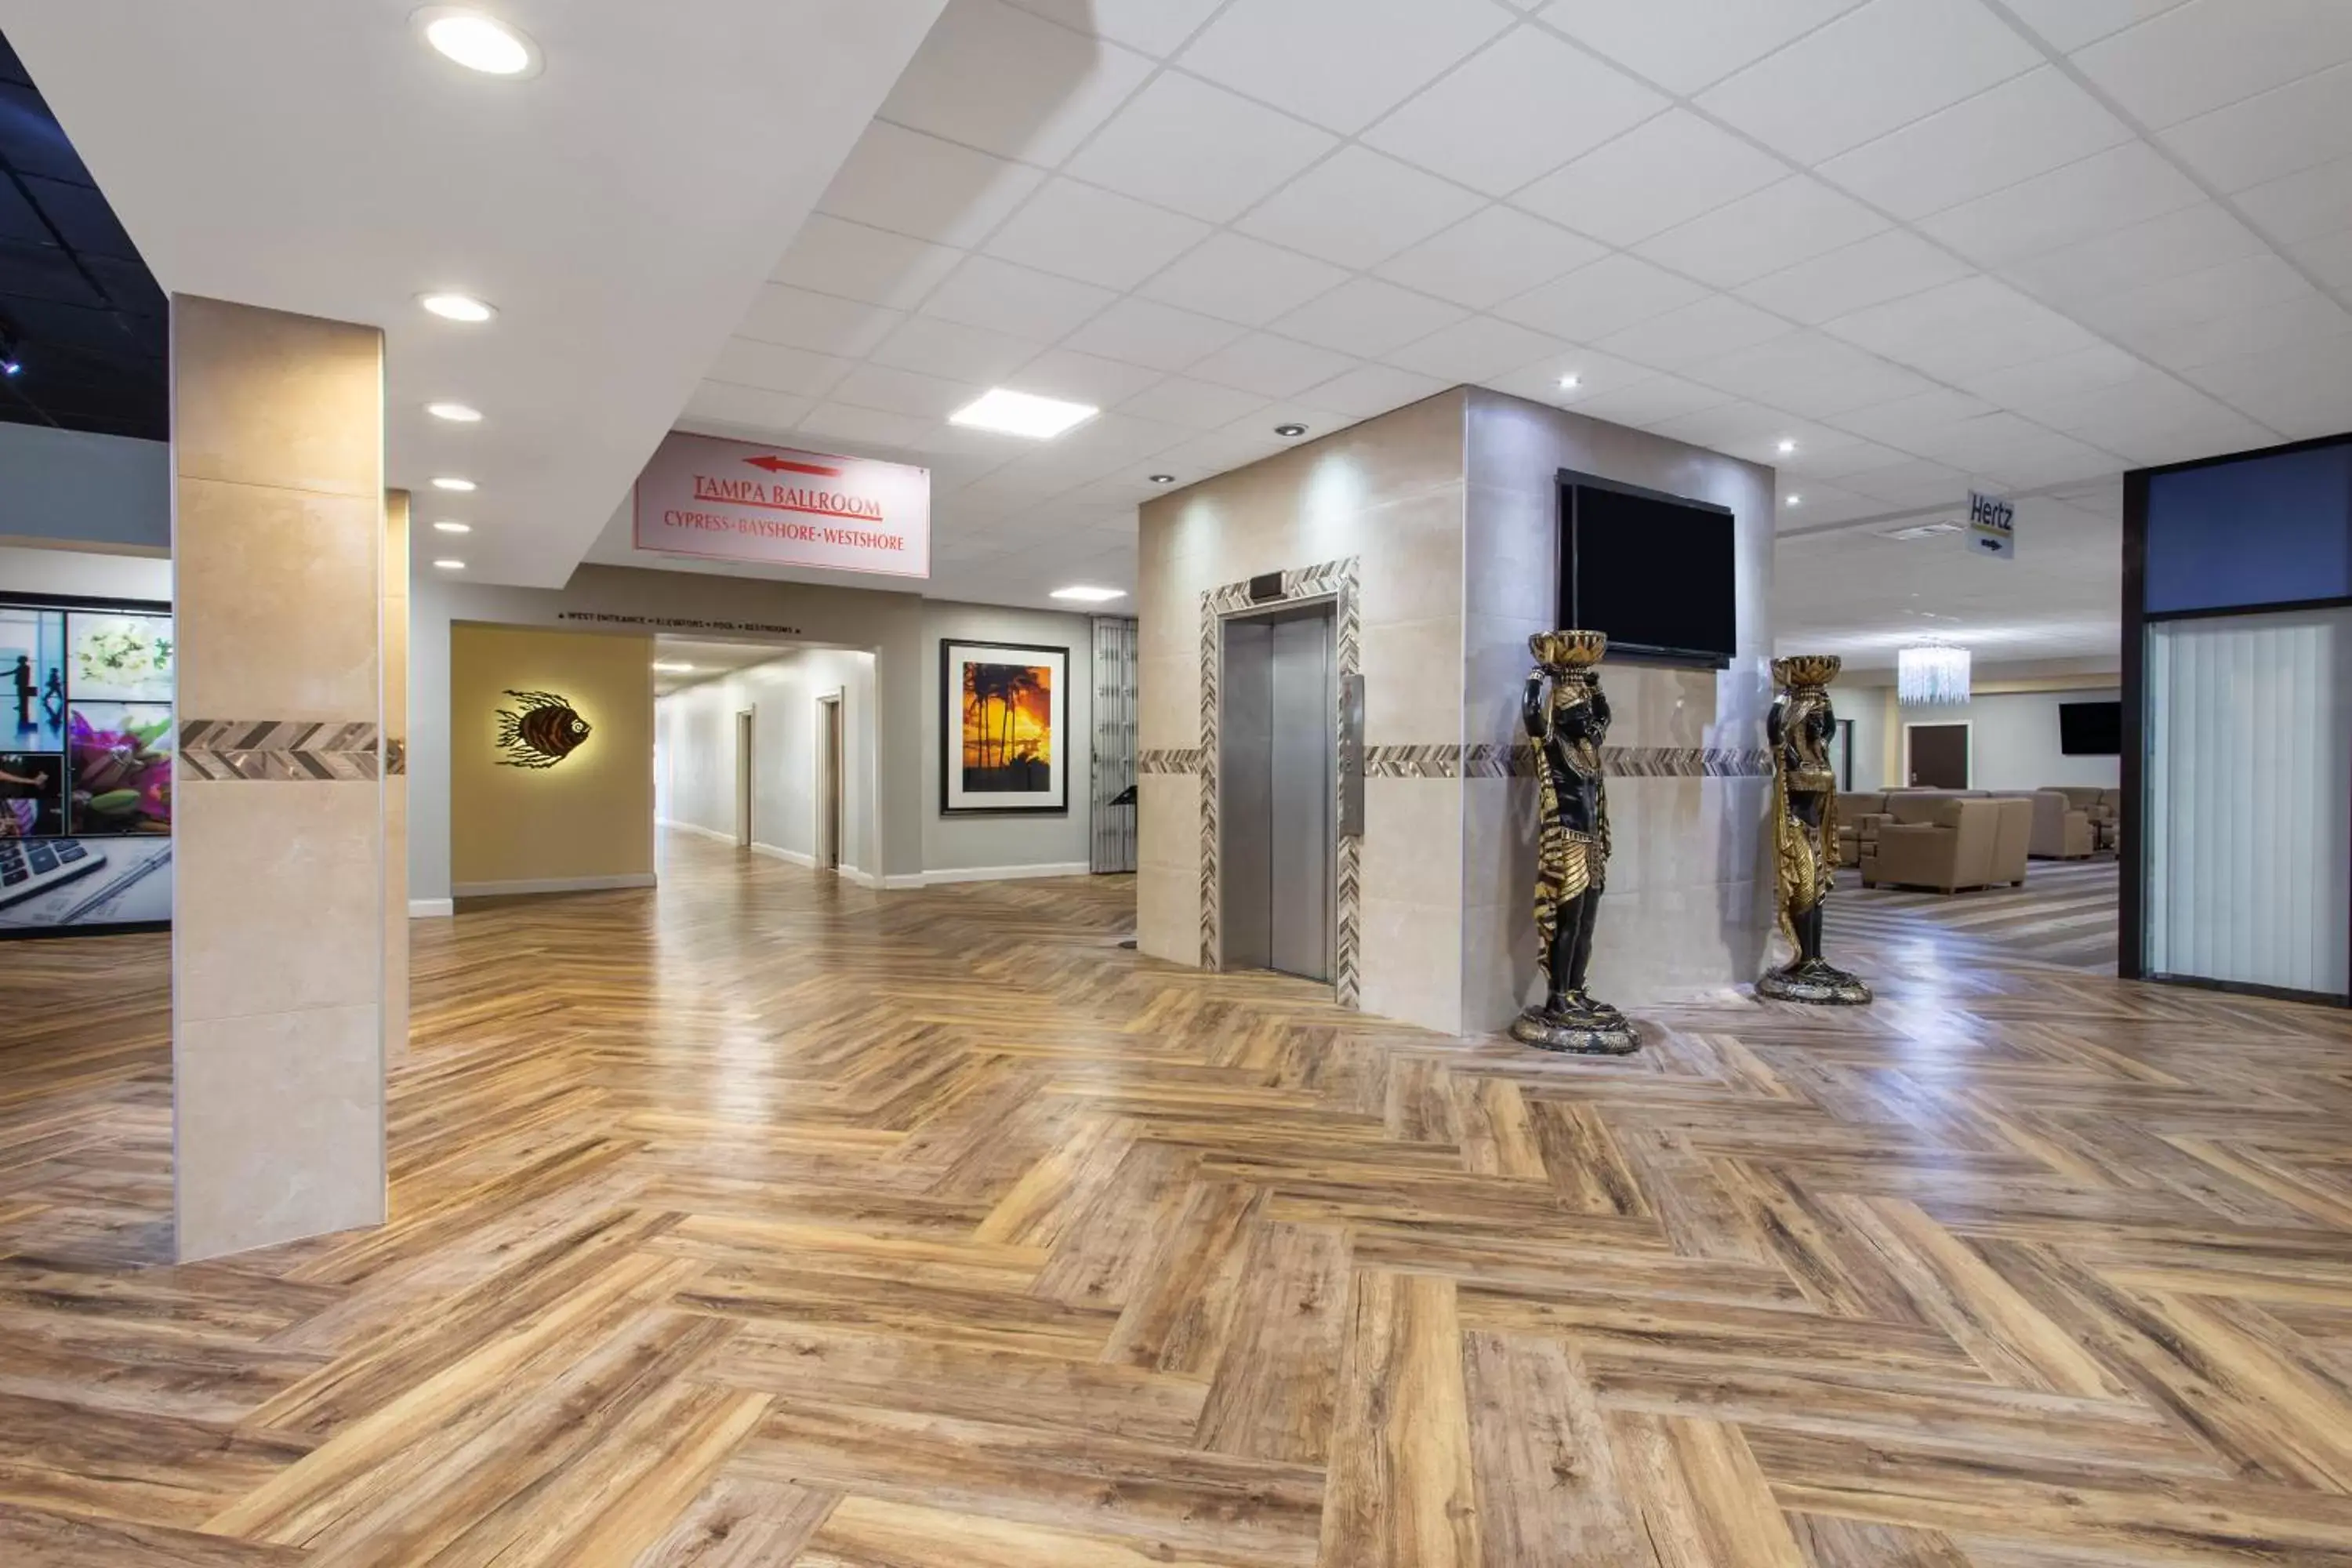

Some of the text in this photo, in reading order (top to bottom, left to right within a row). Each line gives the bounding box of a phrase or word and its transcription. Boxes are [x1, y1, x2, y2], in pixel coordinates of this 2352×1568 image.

[693, 474, 880, 516] TAMPA BALLROOM
[1970, 494, 2013, 531] Hertz
